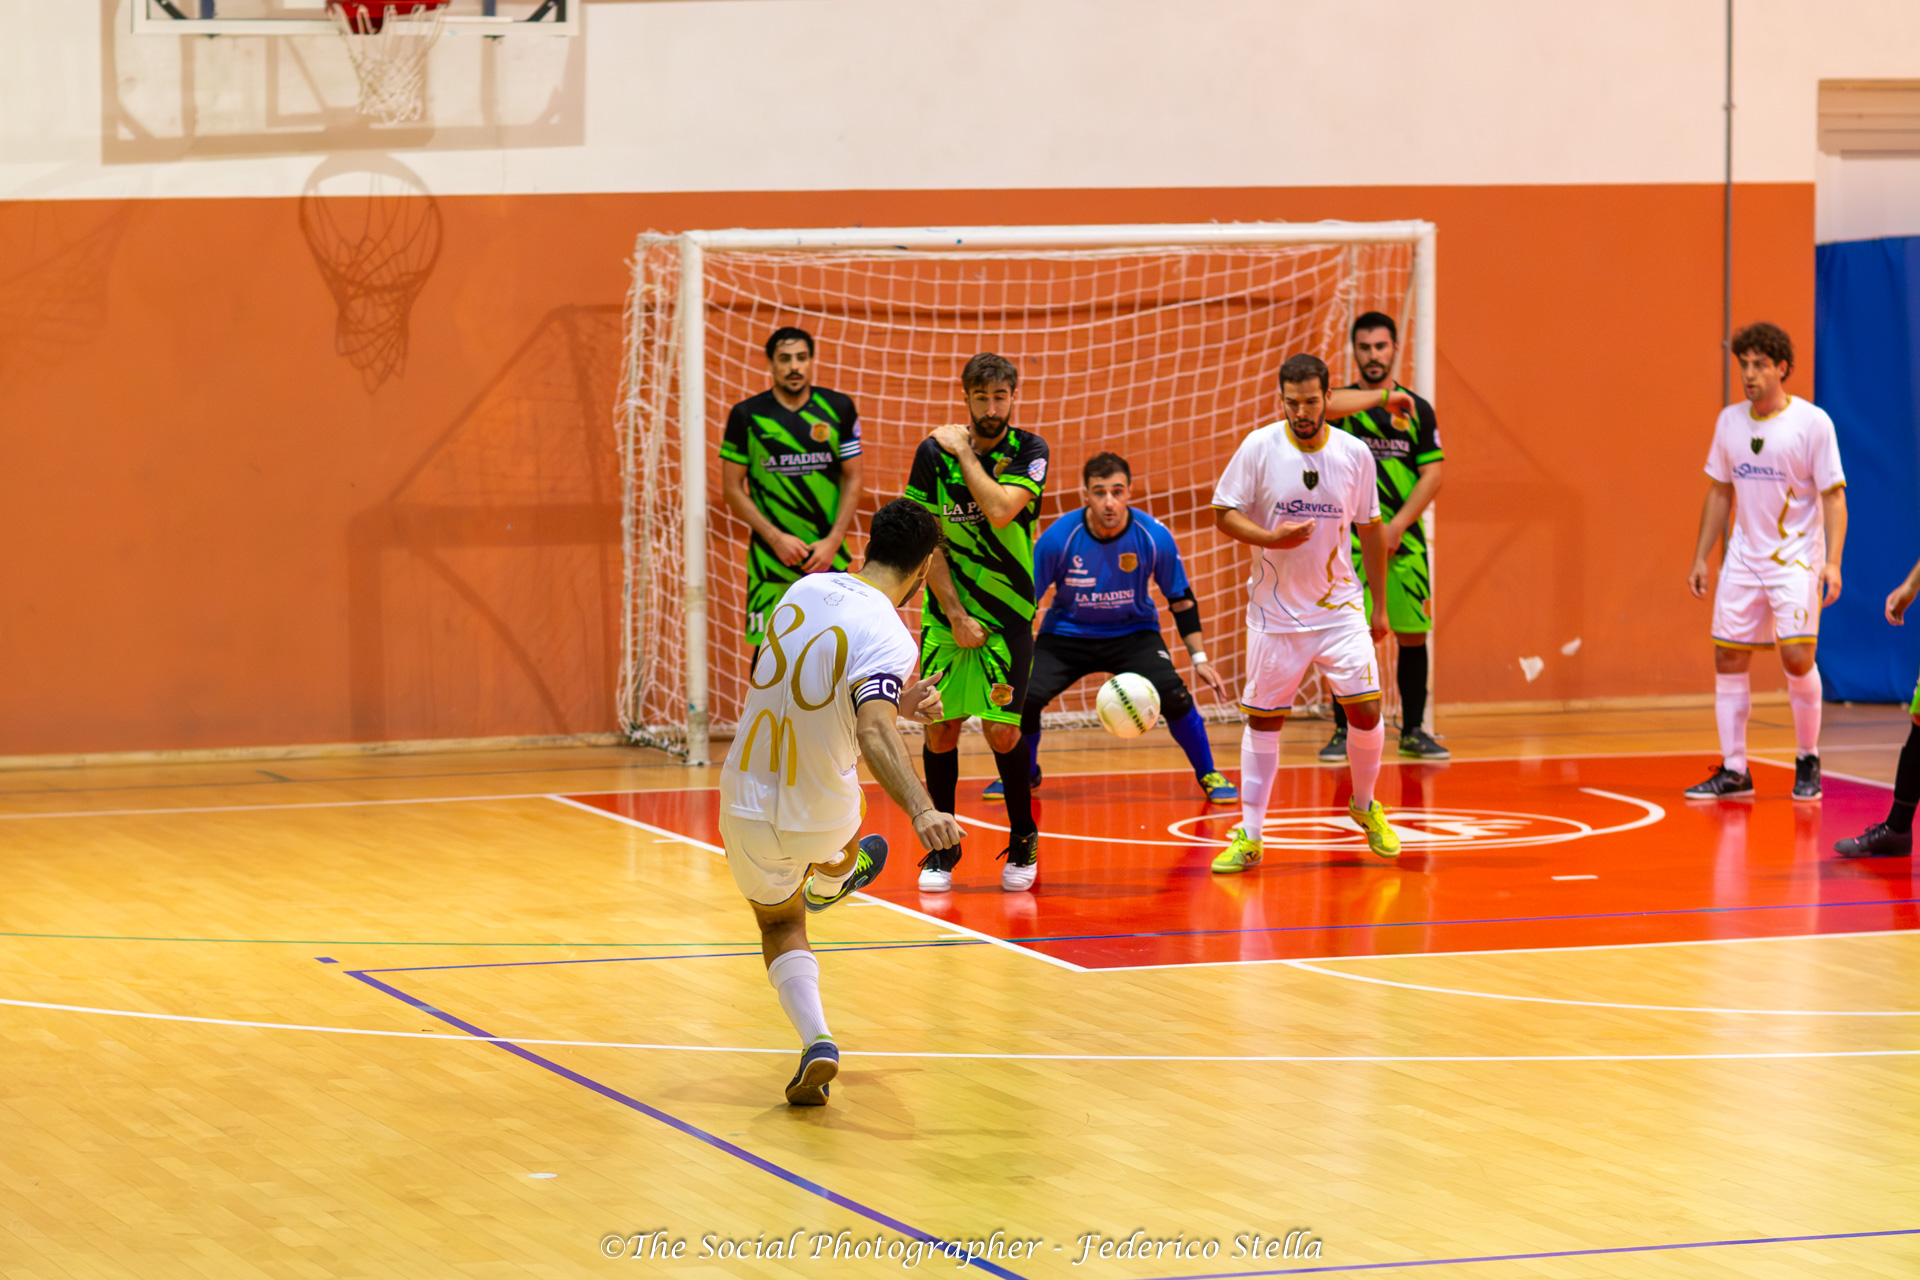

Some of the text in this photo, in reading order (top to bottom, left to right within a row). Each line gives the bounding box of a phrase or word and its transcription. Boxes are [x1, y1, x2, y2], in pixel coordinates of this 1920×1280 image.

[761, 452, 832, 466] LA PIADINA
[943, 503, 964, 515] LA
[1075, 592, 1090, 602] LA
[749, 612, 764, 632] 11
[1793, 607, 1808, 631] 9
[751, 603, 848, 711] 80
[1359, 662, 1374, 686] 4
